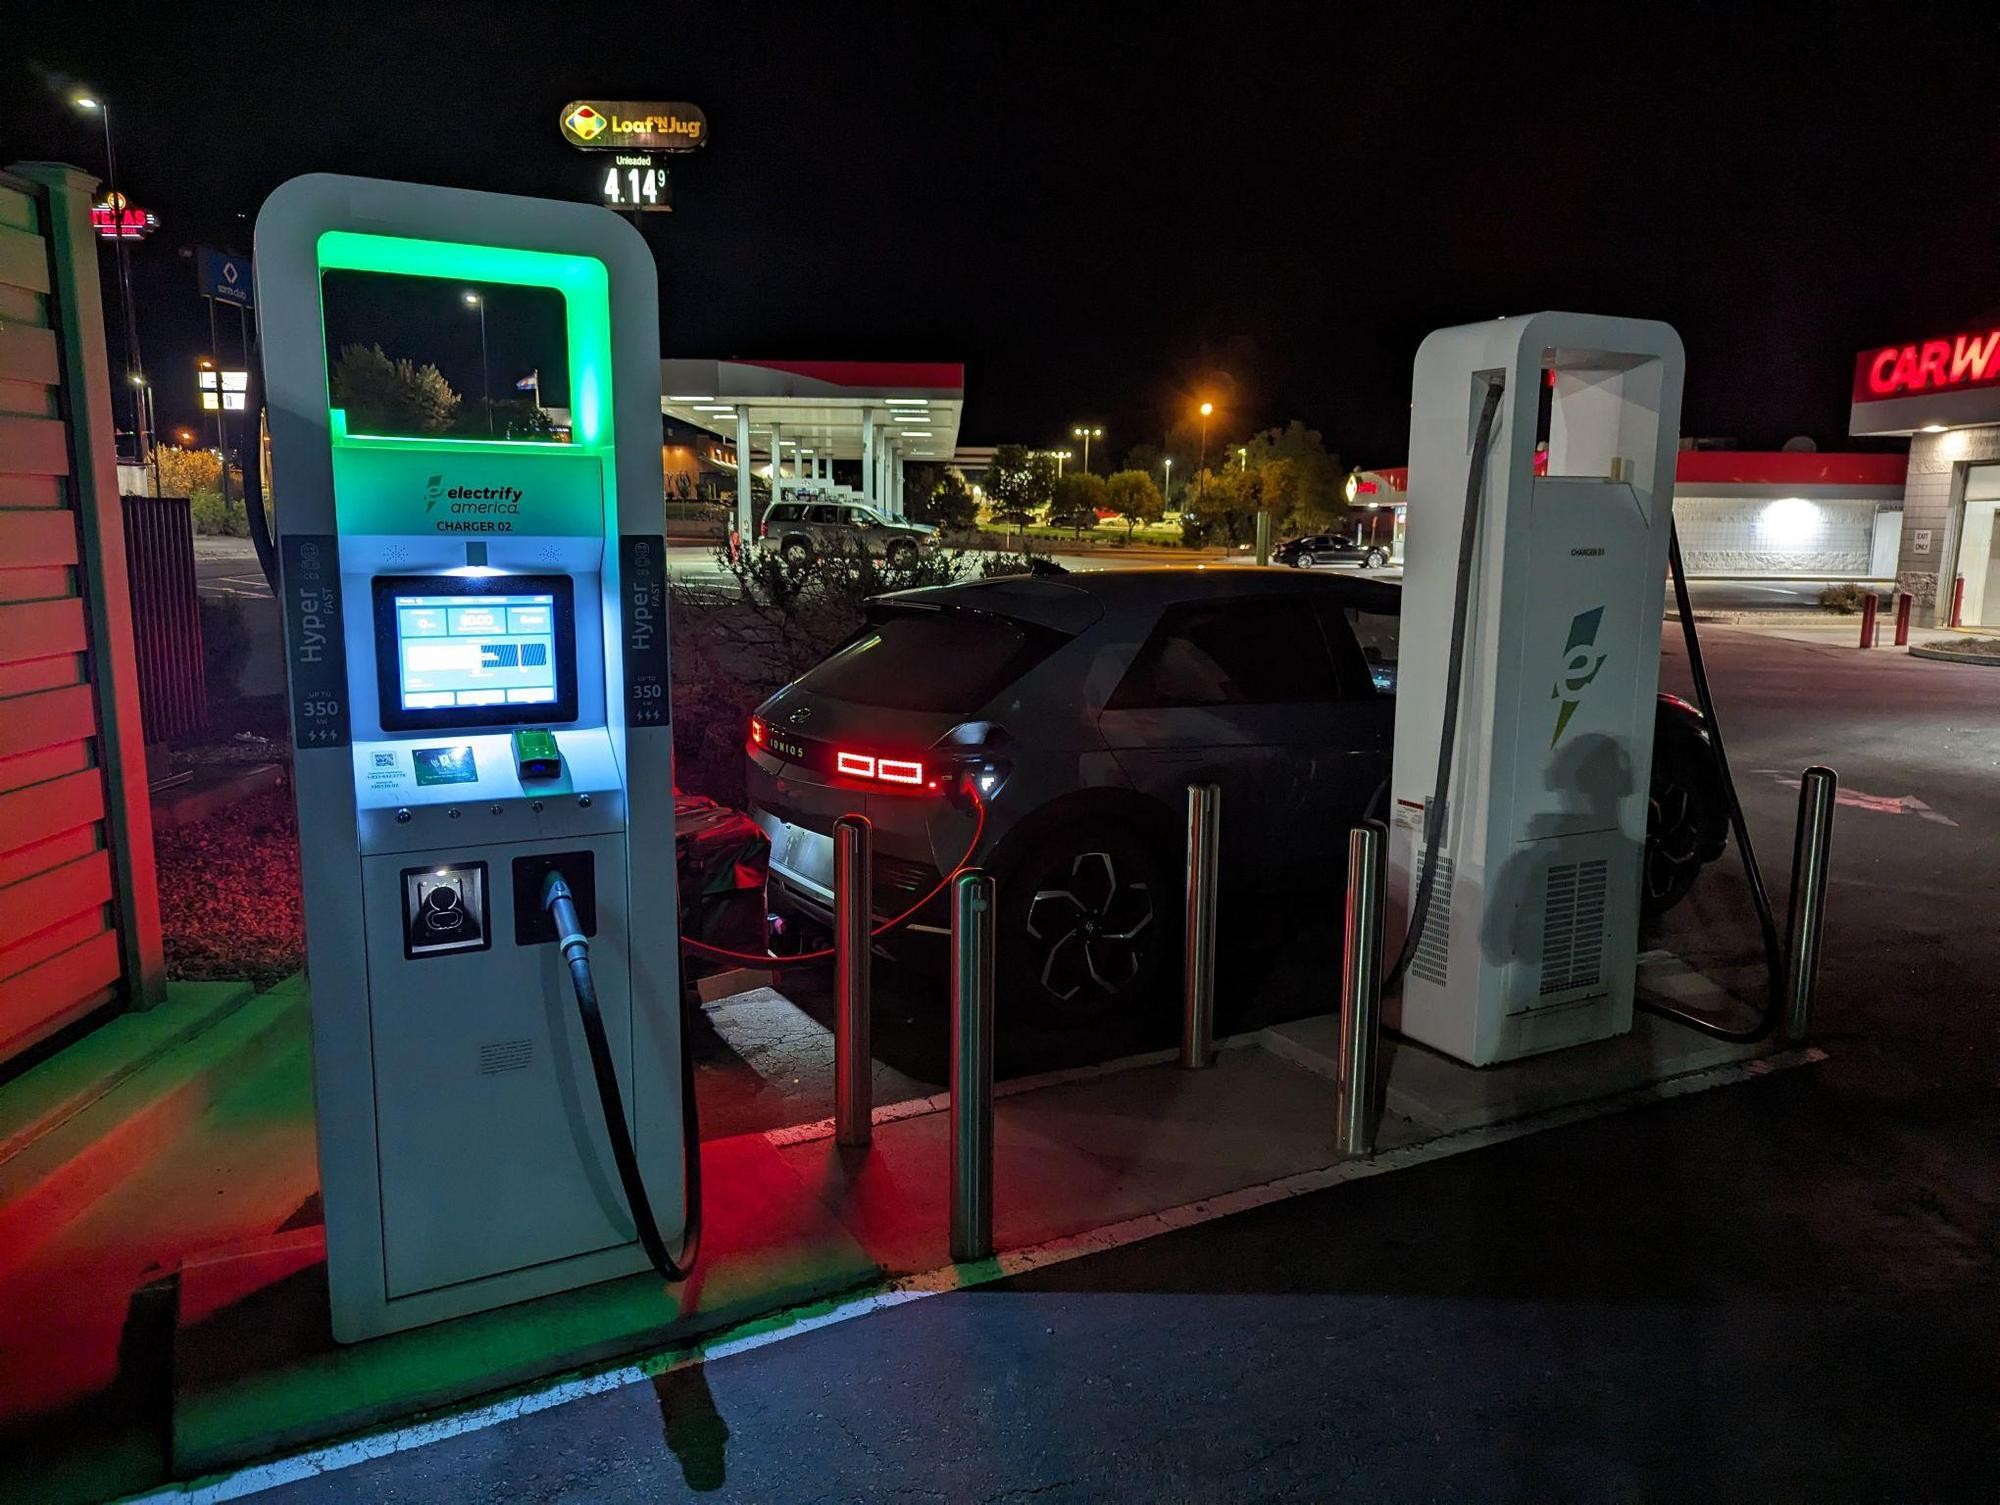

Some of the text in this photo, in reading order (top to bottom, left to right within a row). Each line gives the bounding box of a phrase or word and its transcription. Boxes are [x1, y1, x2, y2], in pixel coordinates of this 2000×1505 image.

[612, 115, 653, 133] Loaf
[668, 117, 701, 138] Jug
[616, 155, 651, 166] Unleaded
[447, 486, 523, 503] electrify
[451, 502, 519, 514] america
[437, 521, 512, 531] CHARGER 02
[1917, 532, 1929, 540] EXIT
[322, 588, 335, 615] FAST
[651, 583, 660, 607] FAST
[632, 582, 653, 650] Hyper
[300, 588, 327, 663] Hyper
[633, 684, 661, 699] 350
[303, 700, 338, 717] 350
[770, 737, 803, 758] IONIQ 5
